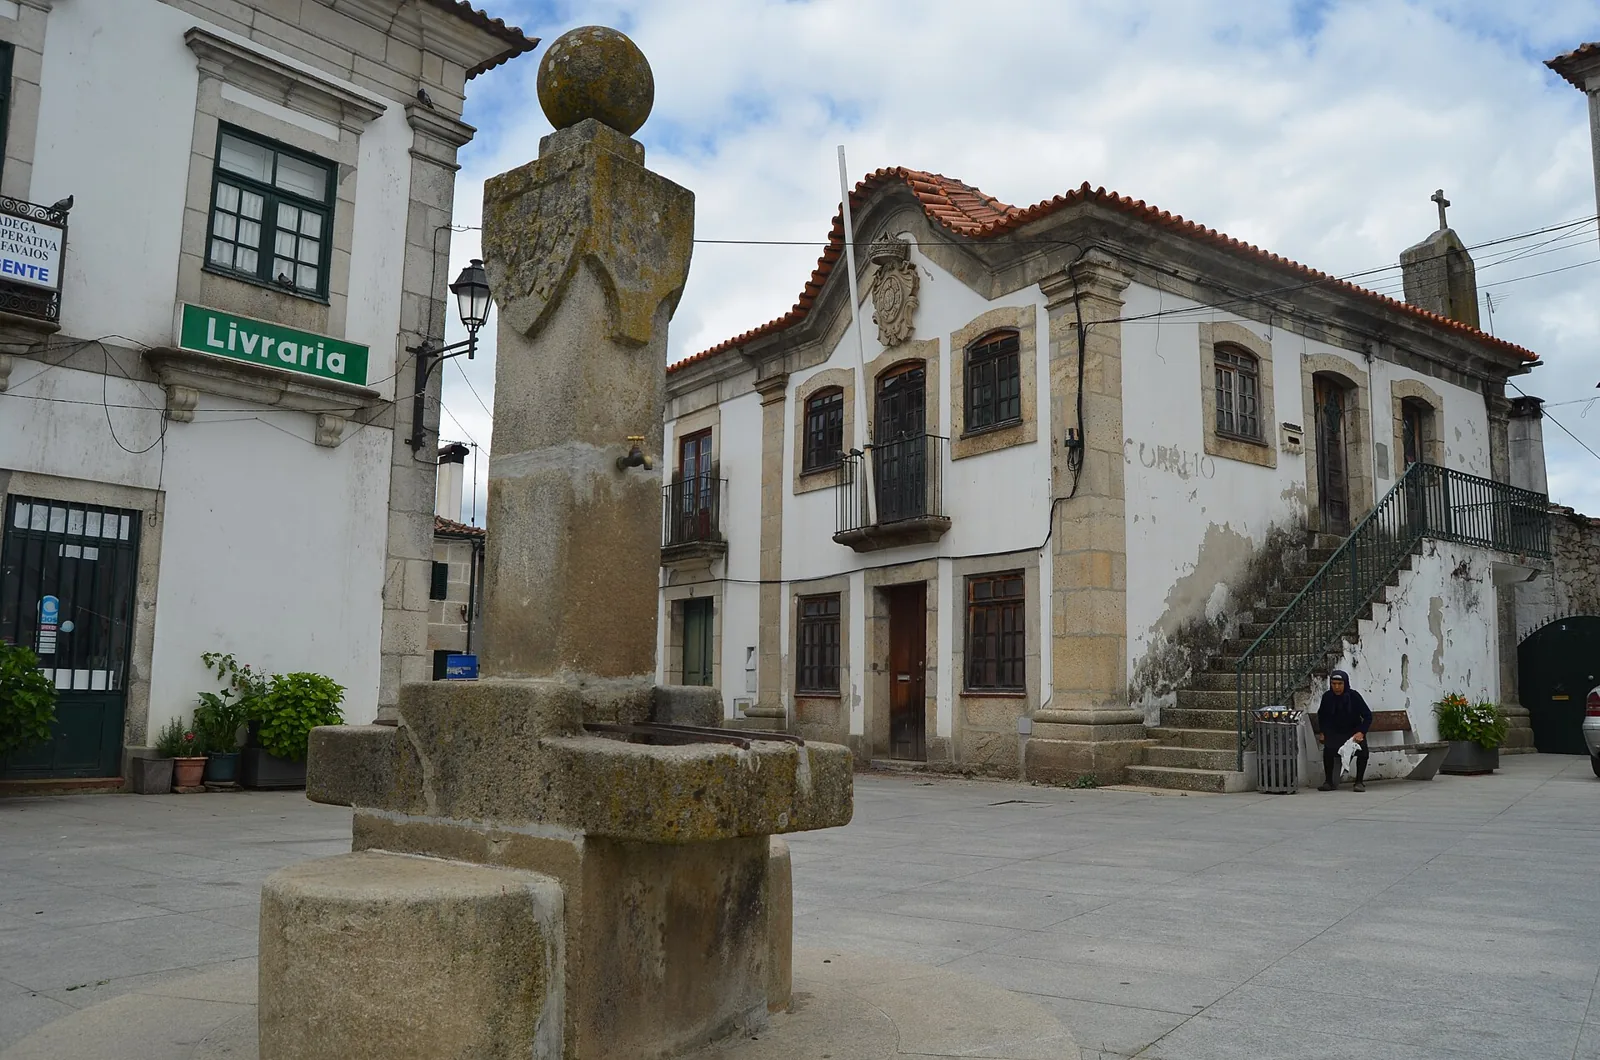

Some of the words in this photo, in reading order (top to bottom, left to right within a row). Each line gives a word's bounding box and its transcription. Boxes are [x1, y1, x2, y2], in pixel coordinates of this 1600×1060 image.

[0, 228, 58, 252] PERATIVA
[1, 240, 49, 261] FAVAIOS
[0, 258, 49, 282] ENTE
[206, 316, 347, 375] Livraria
